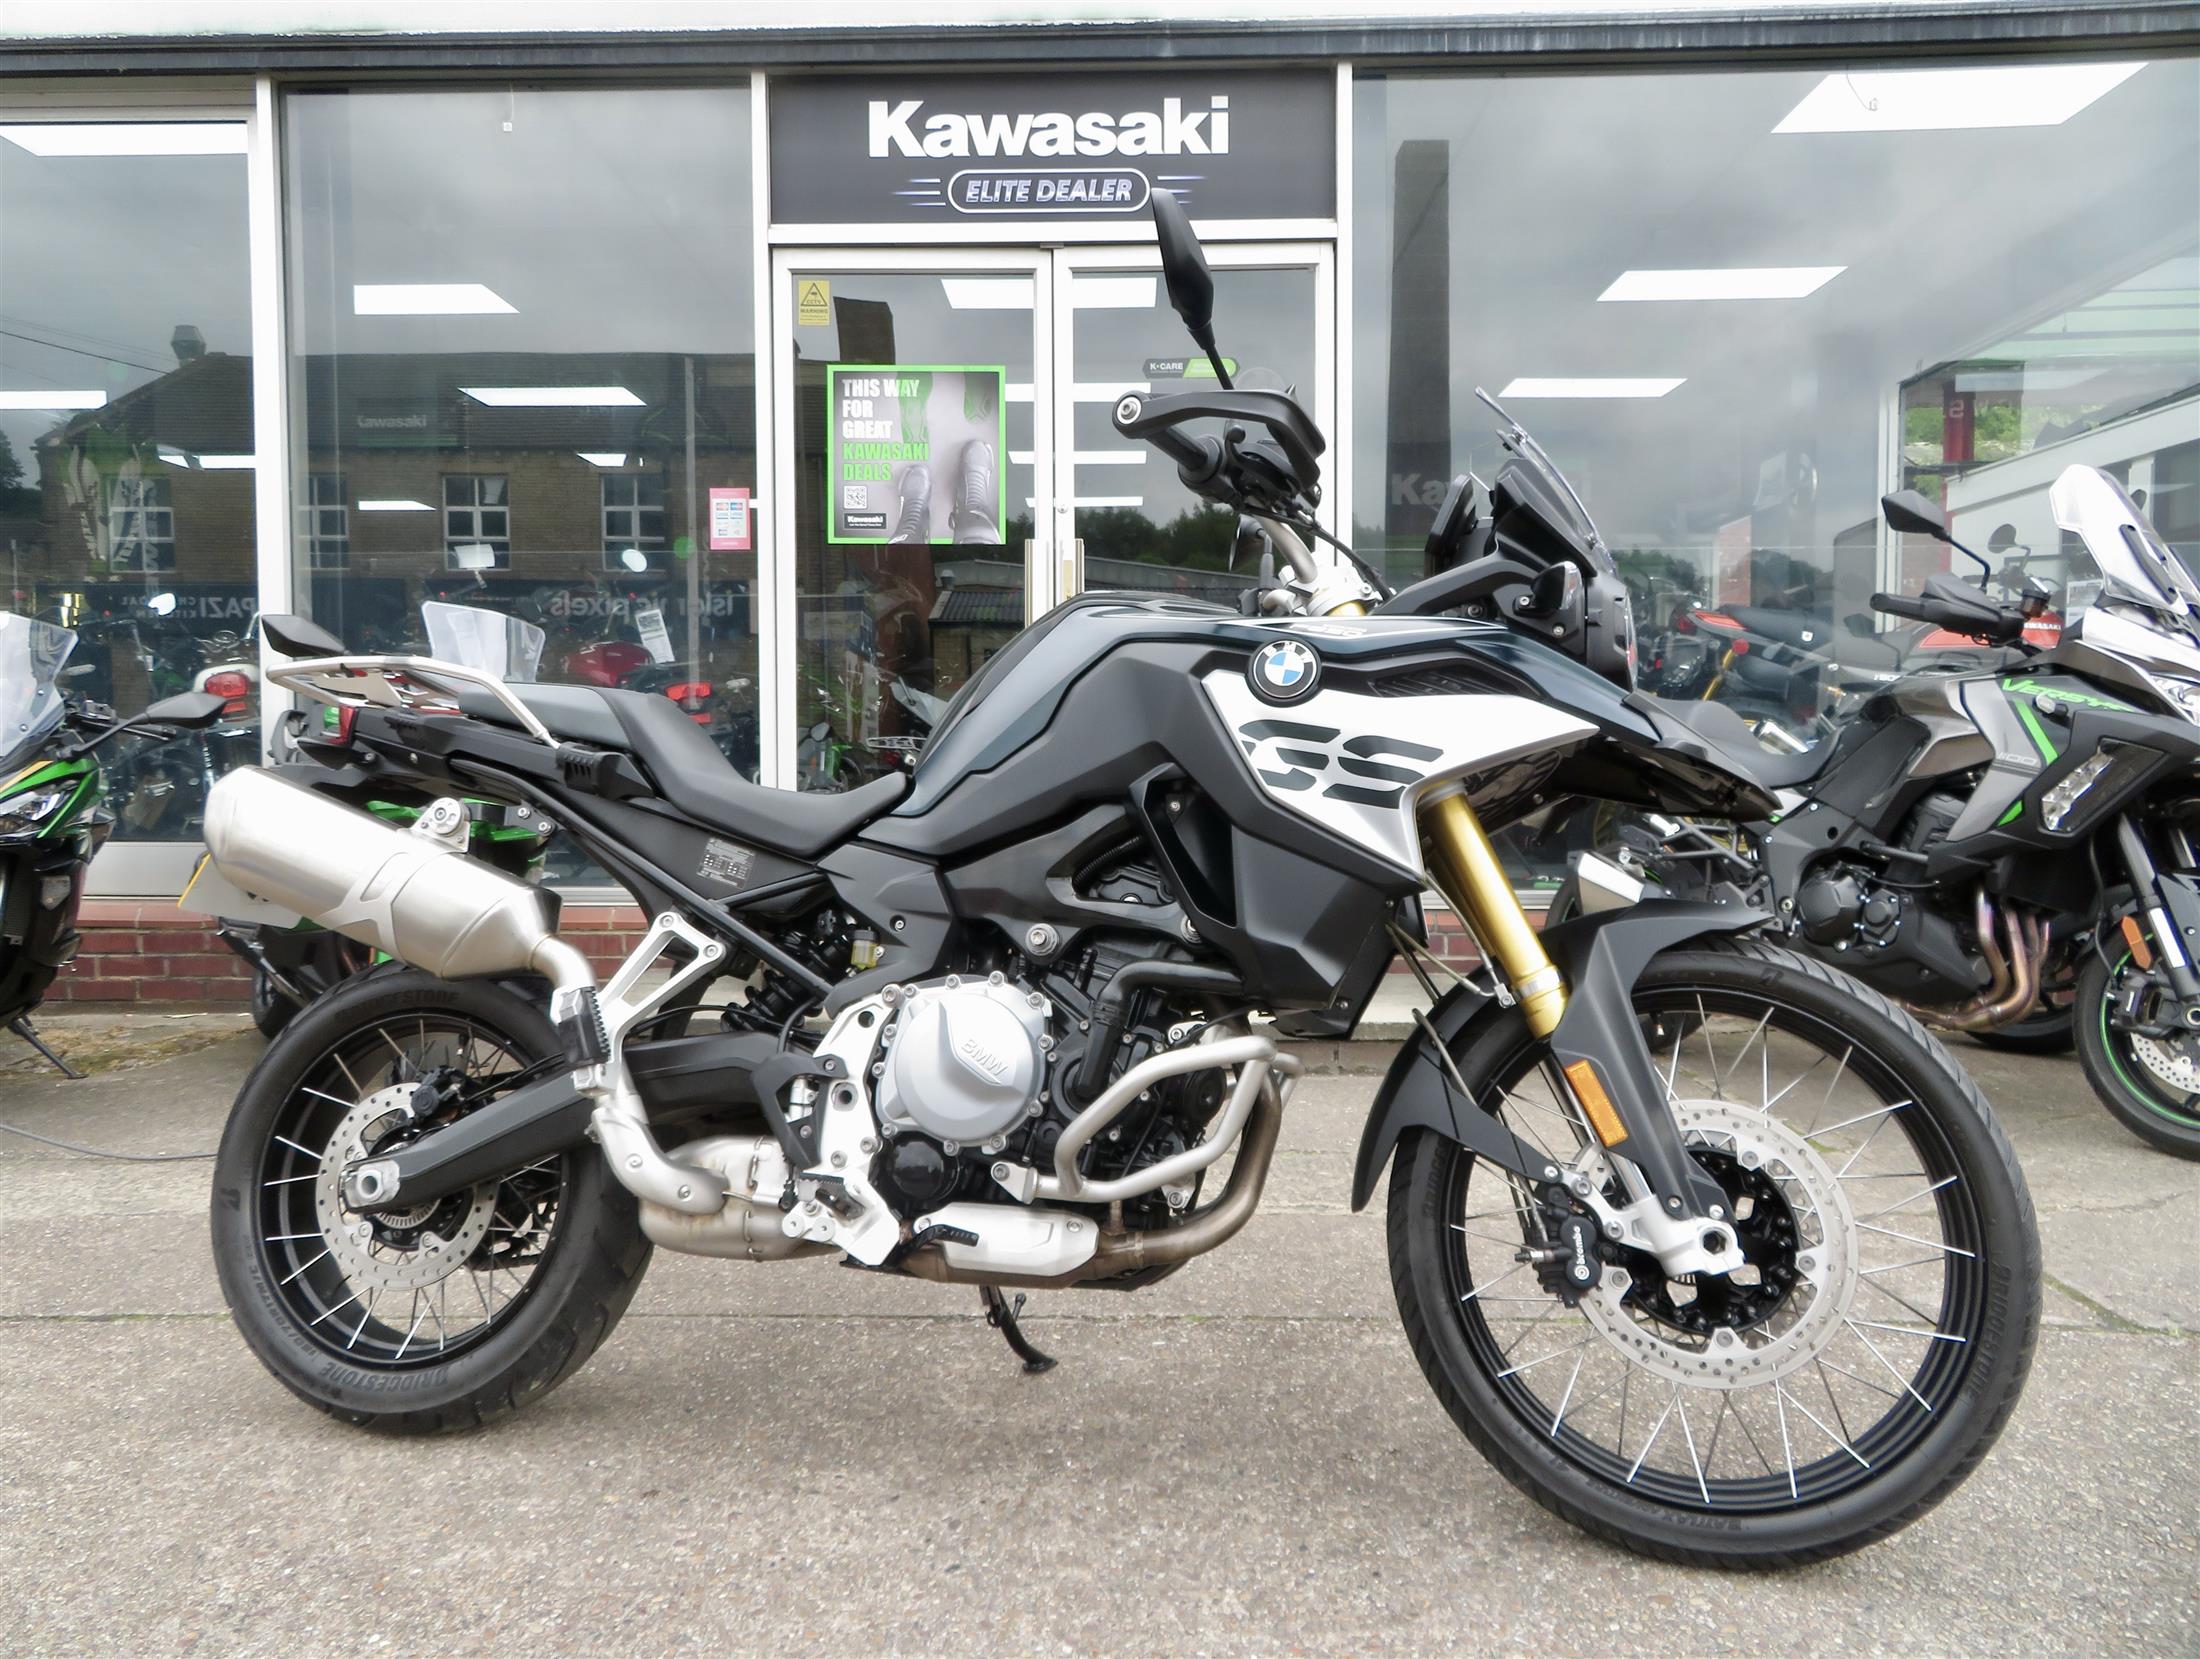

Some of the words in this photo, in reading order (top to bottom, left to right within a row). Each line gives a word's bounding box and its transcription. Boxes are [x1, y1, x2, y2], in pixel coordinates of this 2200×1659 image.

[868, 96, 1229, 157] Kawasaki
[966, 180, 1031, 202] ELITE
[1038, 179, 1134, 202] DEALER
[842, 379, 880, 397] THIS
[883, 379, 920, 397] WAY
[842, 400, 873, 417] FOR
[842, 421, 893, 438] GREAT
[843, 443, 929, 460] KAWASAKI
[843, 464, 892, 481] DEALS
[847, 515, 884, 523] Kawasaki
[1238, 719, 1444, 809] GS
[961, 1038, 1008, 1077] BMW
[319, 1361, 450, 1394] BRIDGESTONE
